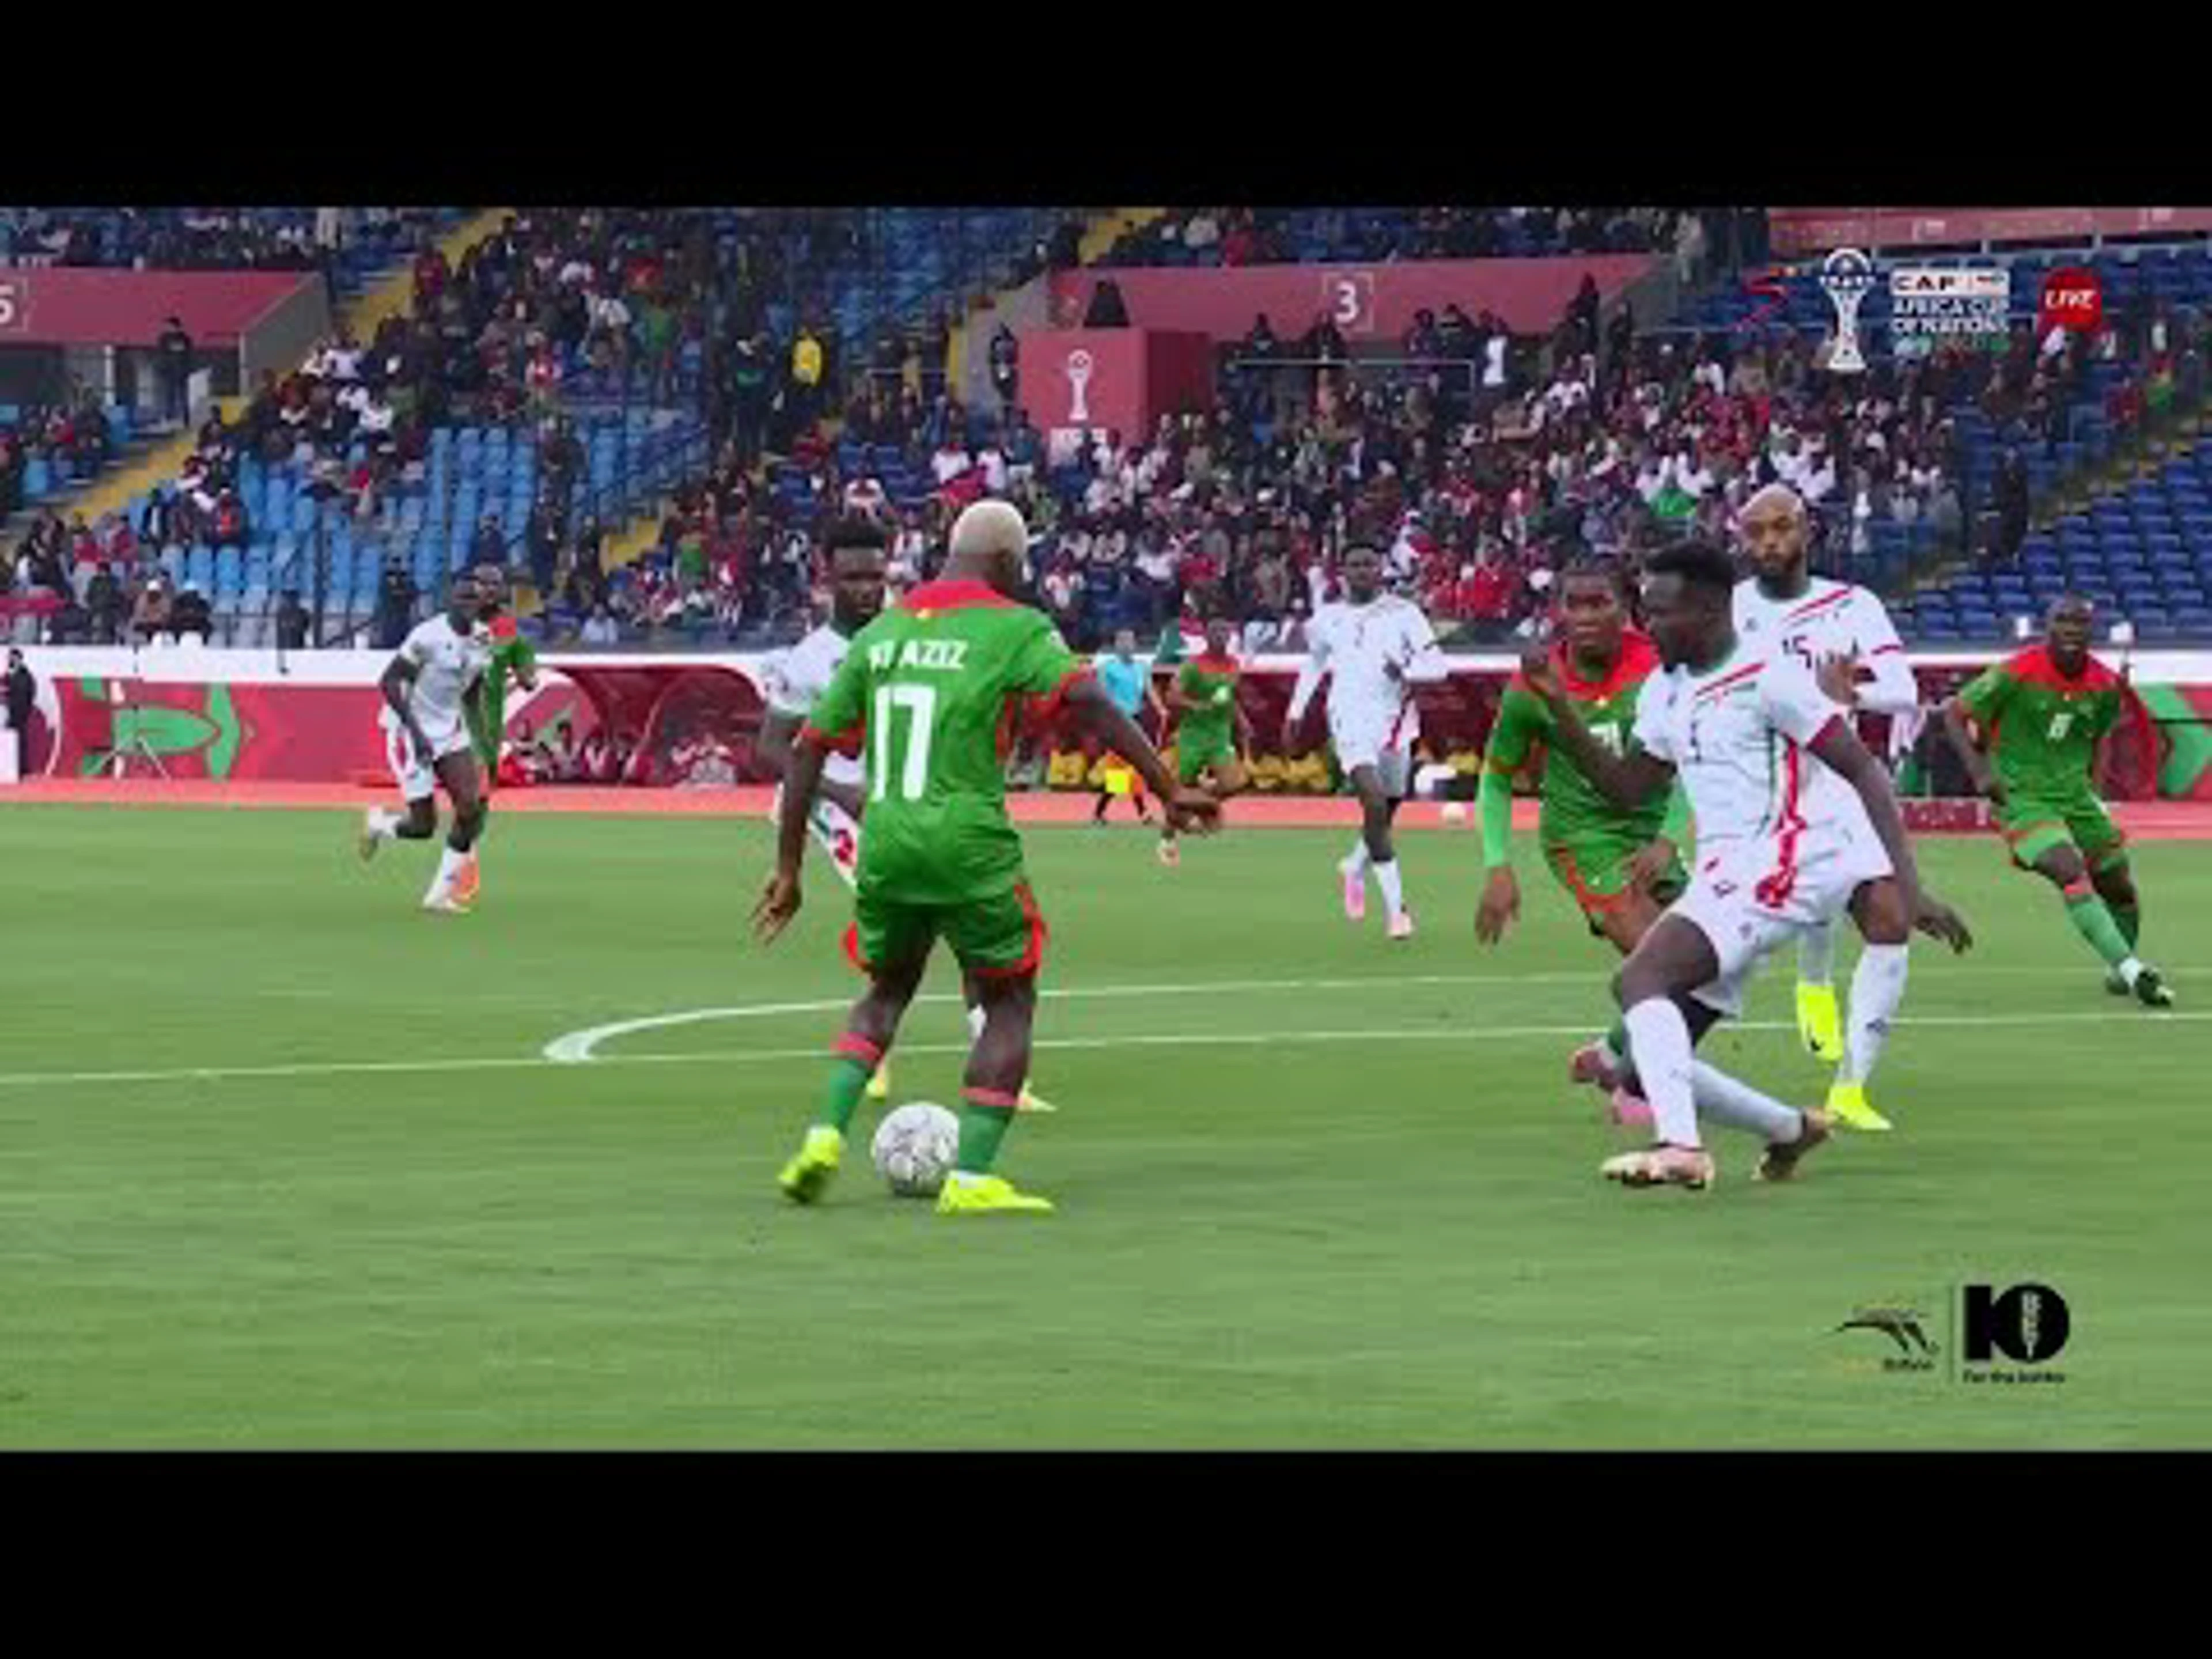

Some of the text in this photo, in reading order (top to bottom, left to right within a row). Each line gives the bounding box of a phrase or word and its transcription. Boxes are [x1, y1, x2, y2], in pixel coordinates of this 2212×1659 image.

[1336, 281, 1359, 323] 3
[897, 640, 969, 669] AZIZ
[874, 684, 936, 801] 17
